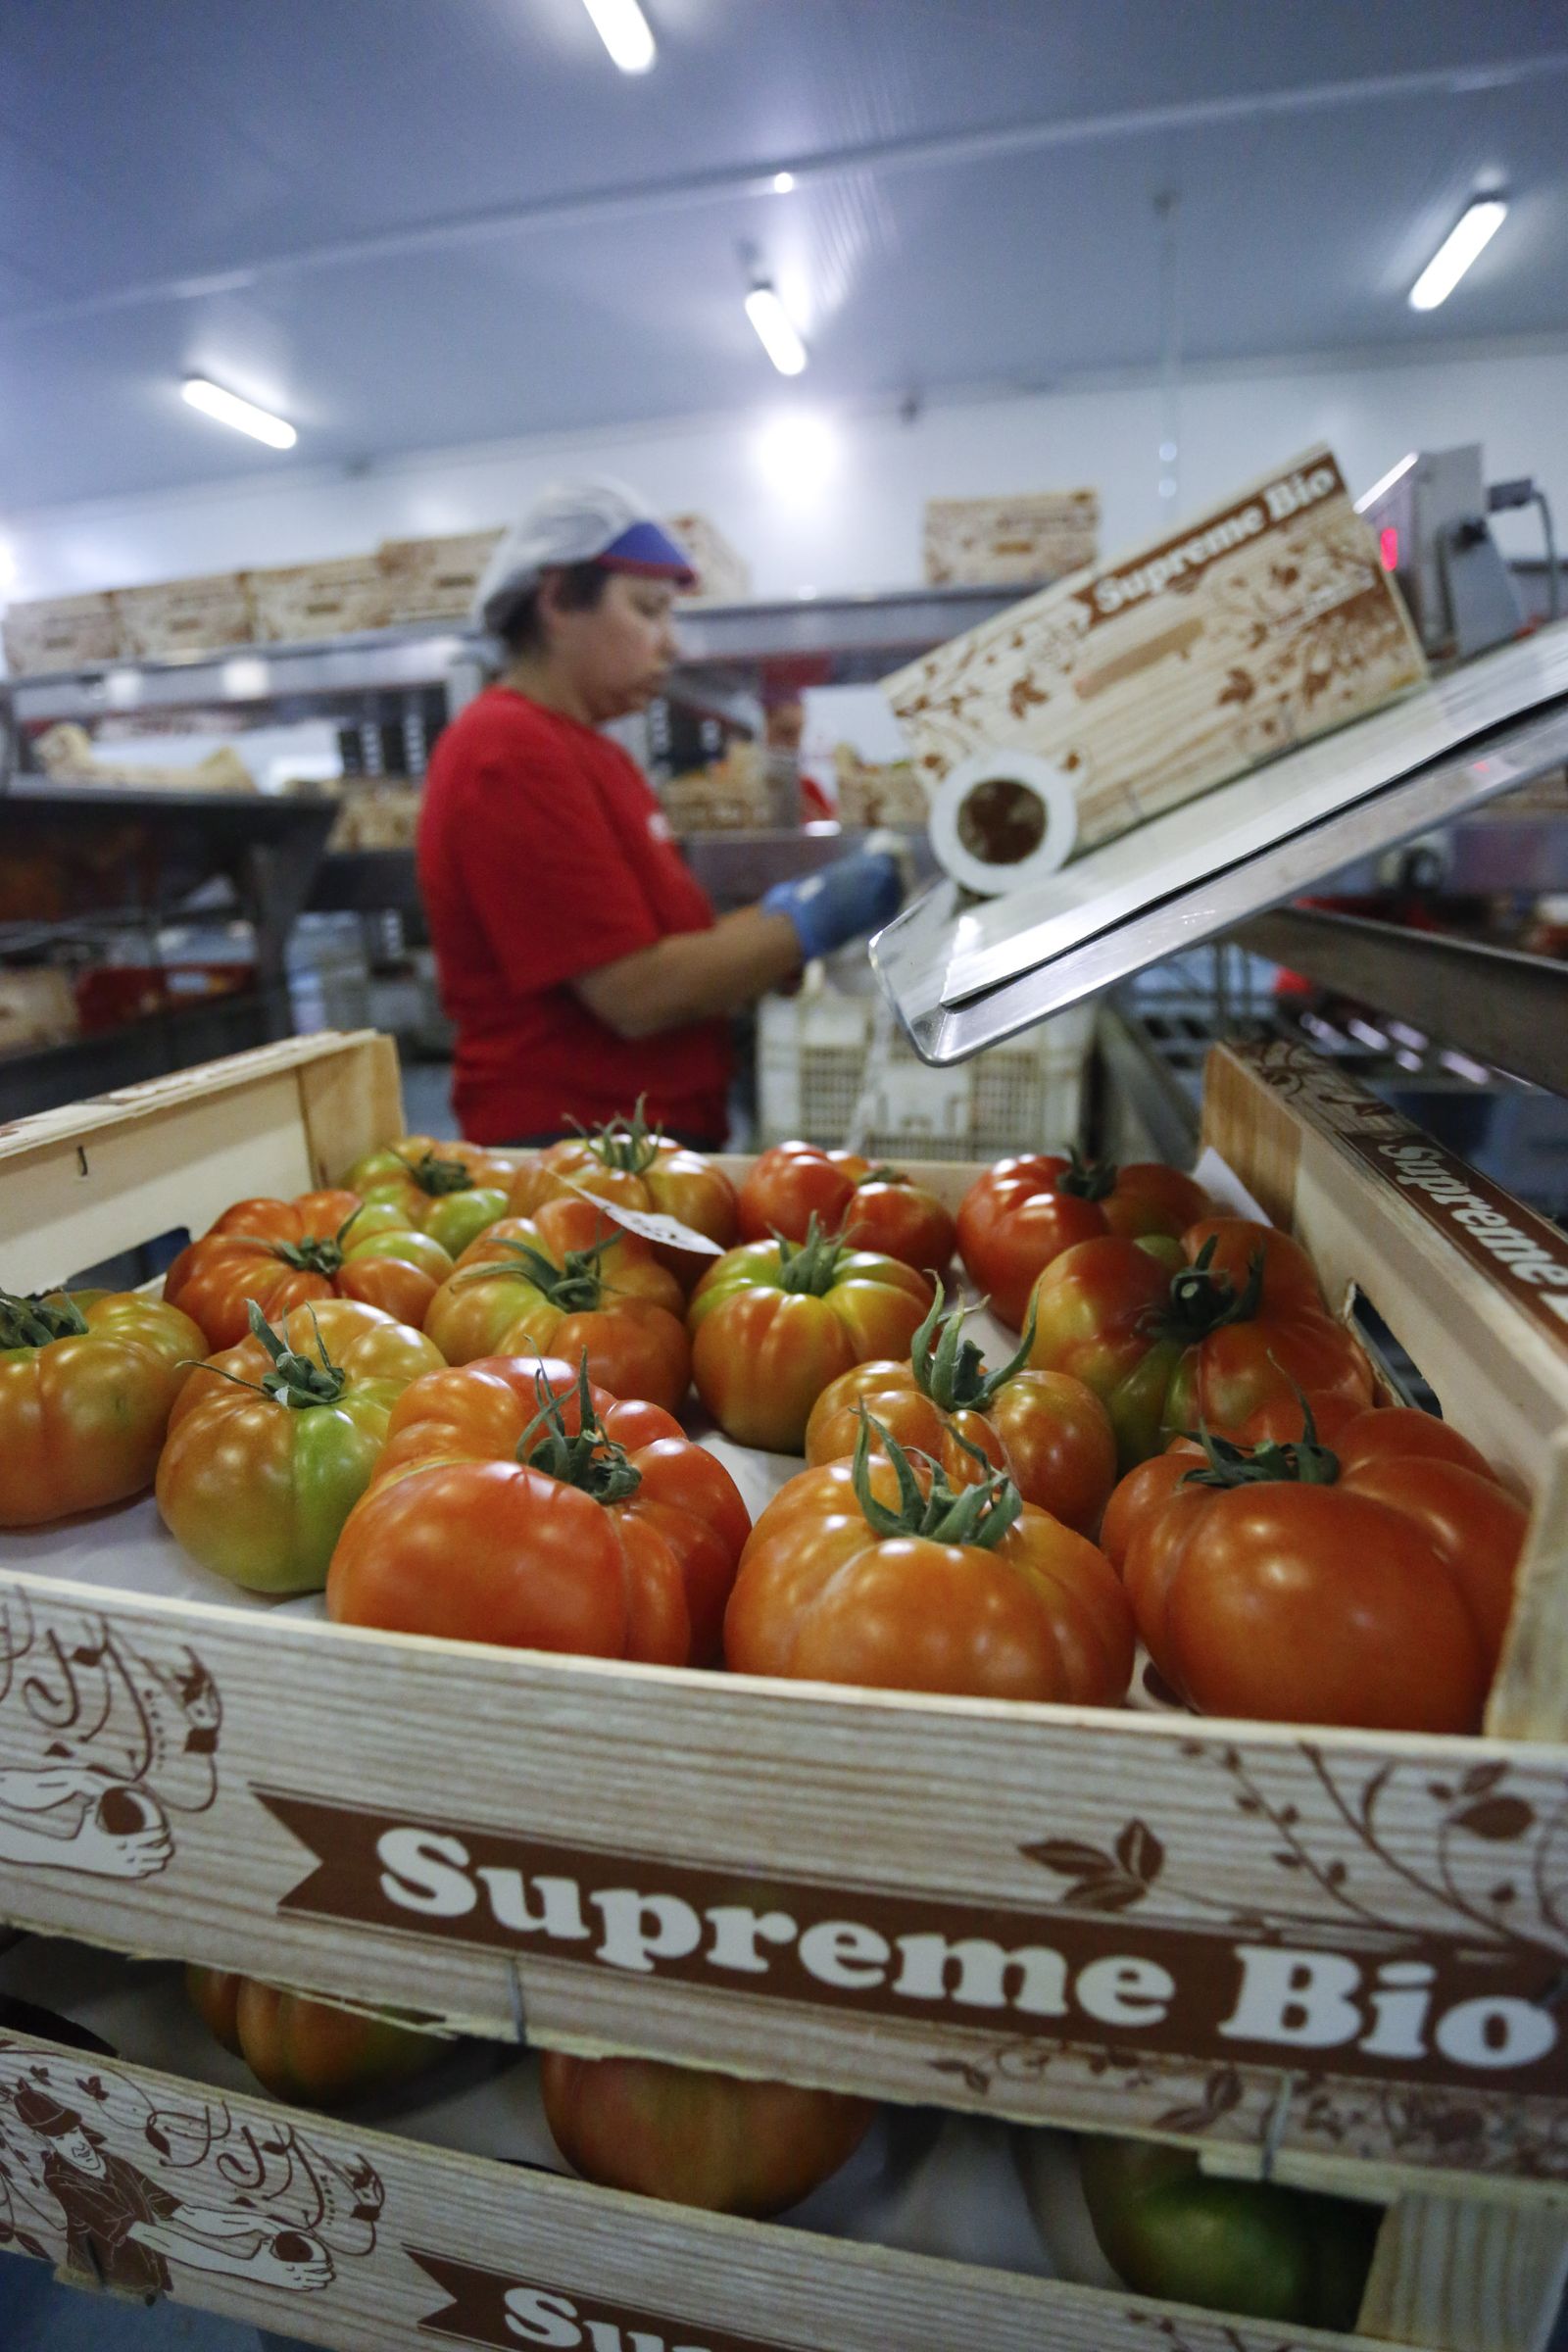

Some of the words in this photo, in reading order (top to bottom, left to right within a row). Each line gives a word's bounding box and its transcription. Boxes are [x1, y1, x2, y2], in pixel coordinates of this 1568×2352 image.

[1093, 506, 1266, 613] Supreme
[1263, 468, 1334, 520] Bio
[1378, 1145, 1568, 1286] Supreme
[376, 1828, 1175, 2027] Supreme
[1217, 1945, 1556, 2069] Bio
